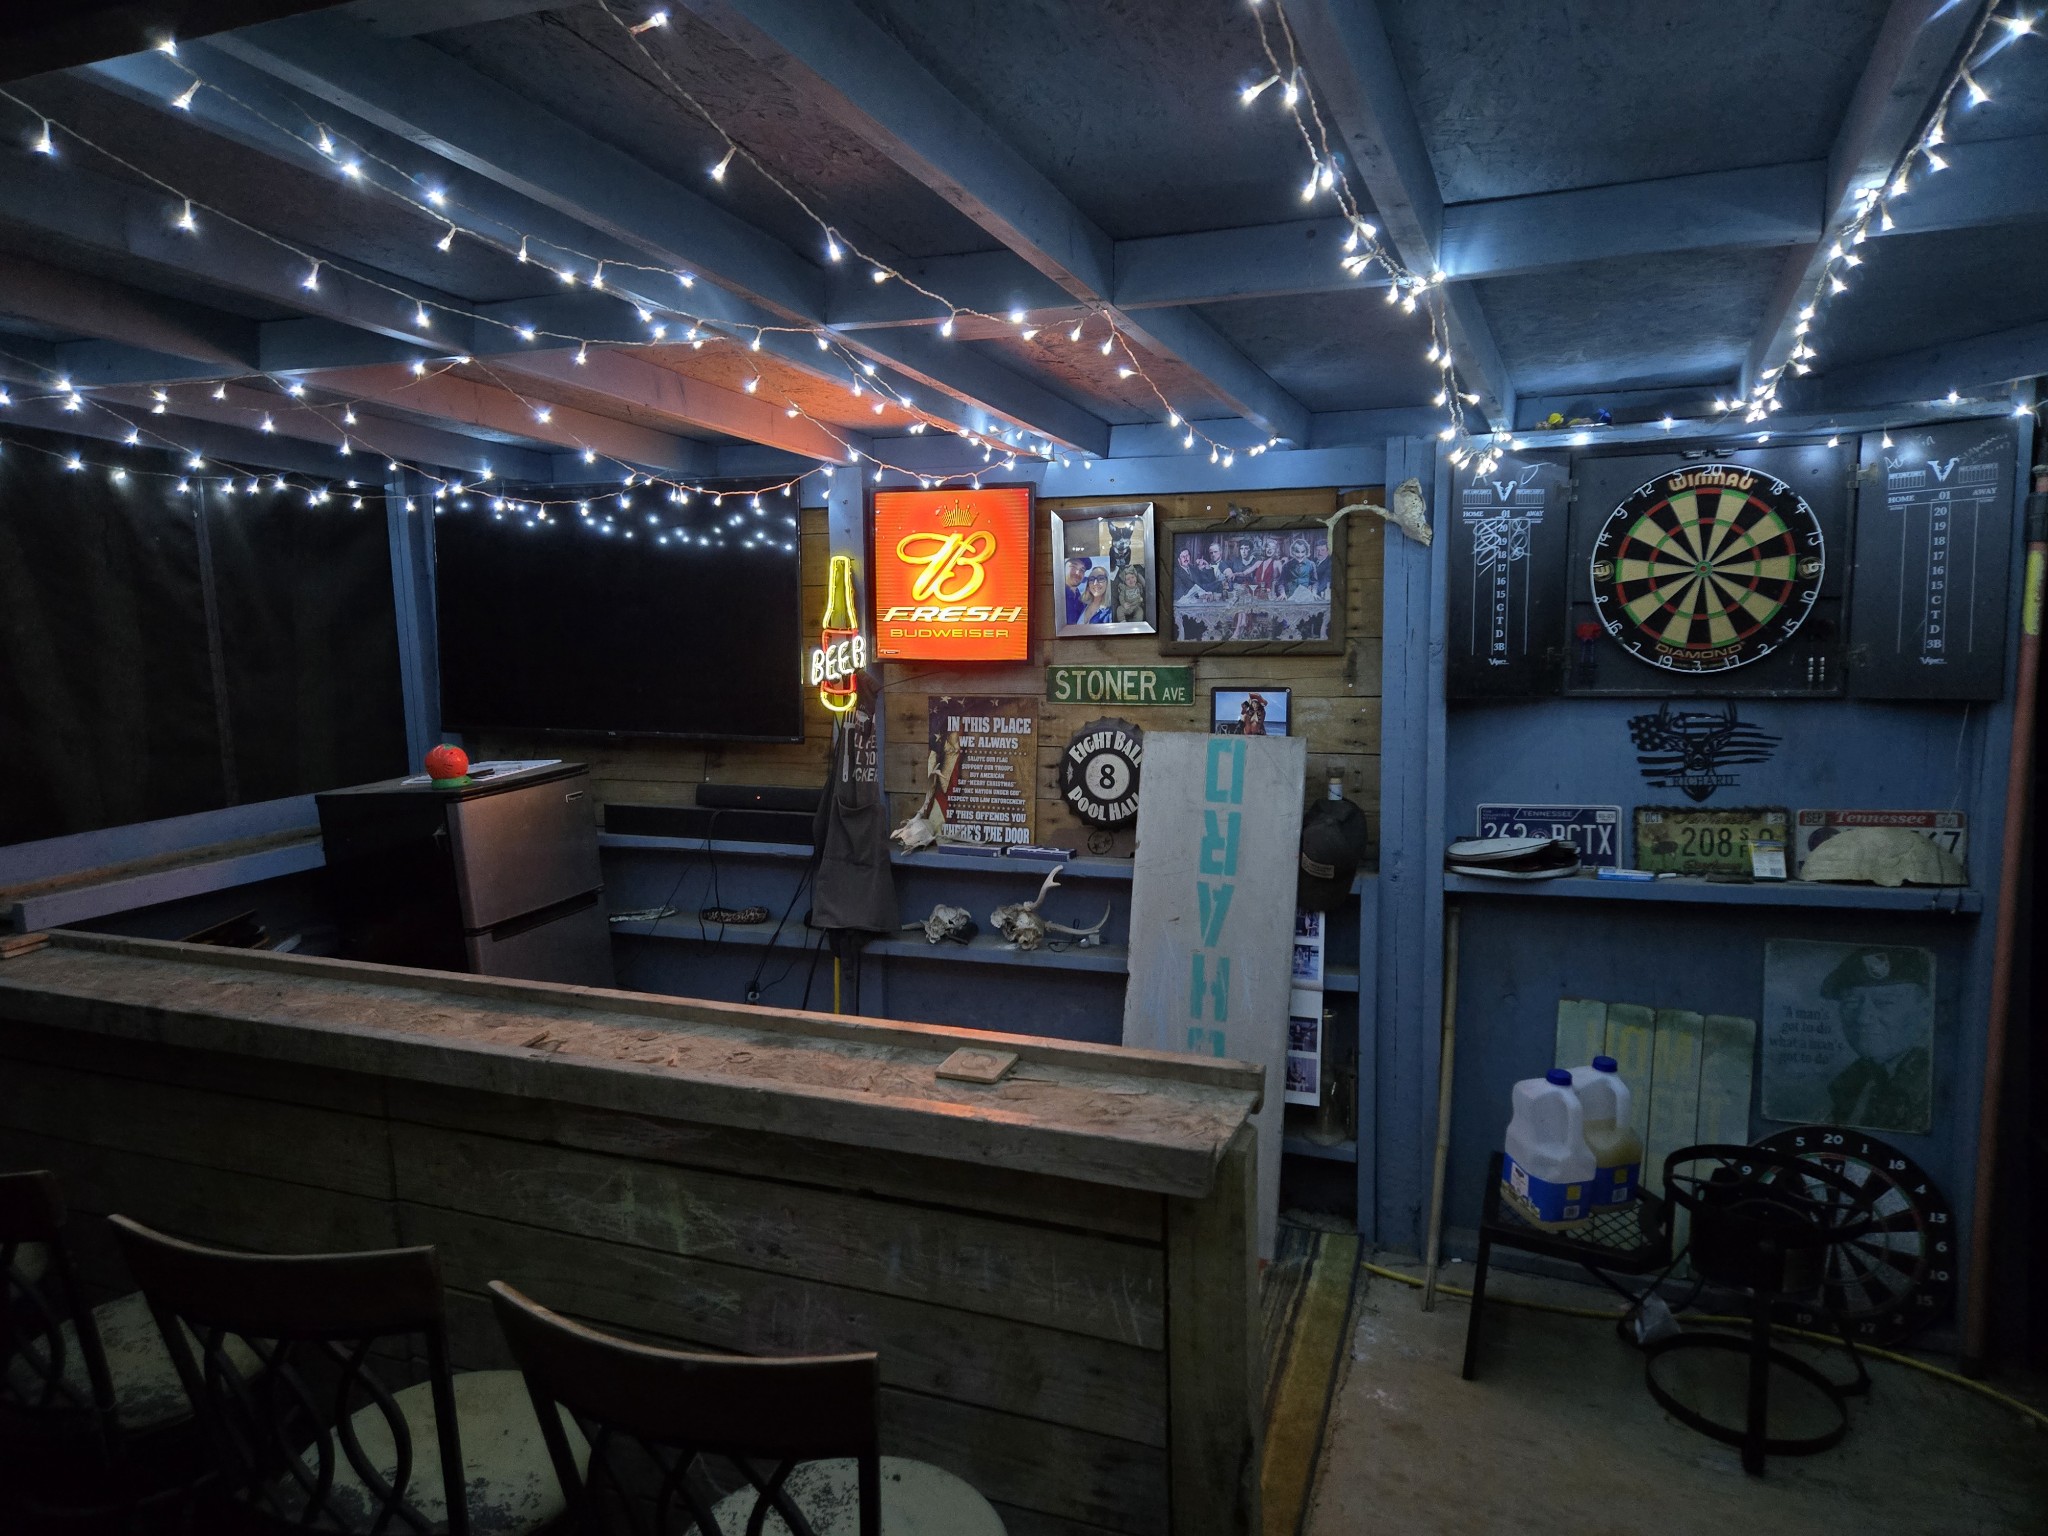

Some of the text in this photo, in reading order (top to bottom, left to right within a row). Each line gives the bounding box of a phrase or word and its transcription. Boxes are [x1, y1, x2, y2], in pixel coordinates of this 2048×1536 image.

[1702, 465, 1723, 476] 20
[1639, 481, 1655, 498] 12
[1770, 479, 1788, 496] 18
[1888, 494, 1915, 504] HOME
[1972, 487, 1997, 496] AWAY
[1616, 506, 1628, 520] 9
[1795, 503, 1808, 514] 4
[1934, 507, 1947, 517] 20
[1934, 522, 1947, 531] 19
[1598, 532, 1613, 547] 14
[1933, 537, 1946, 546] 18
[1933, 551, 1945, 561] 17
[1497, 563, 1506, 572] 17
[1932, 566, 1944, 575] 16
[1496, 577, 1506, 585] 16
[1931, 581, 1943, 590] 15
[1496, 590, 1506, 598] 15
[1595, 594, 1609, 604] 8
[1932, 596, 1941, 605] C
[1496, 603, 1505, 612] C
[882, 606, 1022, 622] FRESH
[1931, 610, 1941, 619] T
[1496, 616, 1504, 625] T
[1781, 618, 1799, 633] 15
[1606, 619, 1623, 636] 16
[1930, 625, 1940, 634] D
[890, 629, 1009, 638] BUDWEISER
[1496, 629, 1504, 638] D
[1493, 642, 1505, 651] 3B
[1757, 643, 1771, 654] 2
[1926, 639, 1942, 649] 3B
[1654, 641, 1742, 659] DIAMOND
[811, 634, 866, 686] BEER
[1658, 655, 1673, 668] 19
[1724, 655, 1740, 666] 17
[1693, 661, 1703, 672] 3
[1055, 670, 1185, 701] STONER AVE
[947, 716, 1031, 734] IN THIS PLACE
[959, 735, 1018, 749] WE ALWAYS
[1069, 731, 1113, 764] EIGHT
[1100, 764, 1115, 789] 8
[1672, 776, 1733, 786] RICHARD
[1067, 785, 1107, 821] POOL
[946, 810, 1026, 822] IF THIS OFFENDS YOU
[1806, 813, 1823, 823] SEP
[1835, 812, 1927, 824] Tennessee
[984, 826, 1002, 842] THE
[1005, 827, 1029, 844] DOOR
[1740, 828, 1749, 840] S
[1682, 828, 1732, 857] 208
[1795, 1137, 1805, 1147] 5
[1823, 1134, 1844, 1145] 20
[1861, 1143, 1869, 1154] 1
[1741, 1165, 1752, 1175] 9
[1888, 1159, 1906, 1170] 18
[1914, 1184, 1927, 1194] 4
[1928, 1212, 1947, 1223] 13
[1935, 1241, 1948, 1252] 6
[1929, 1270, 1948, 1281] 10
[1859, 1323, 1876, 1334] 17
